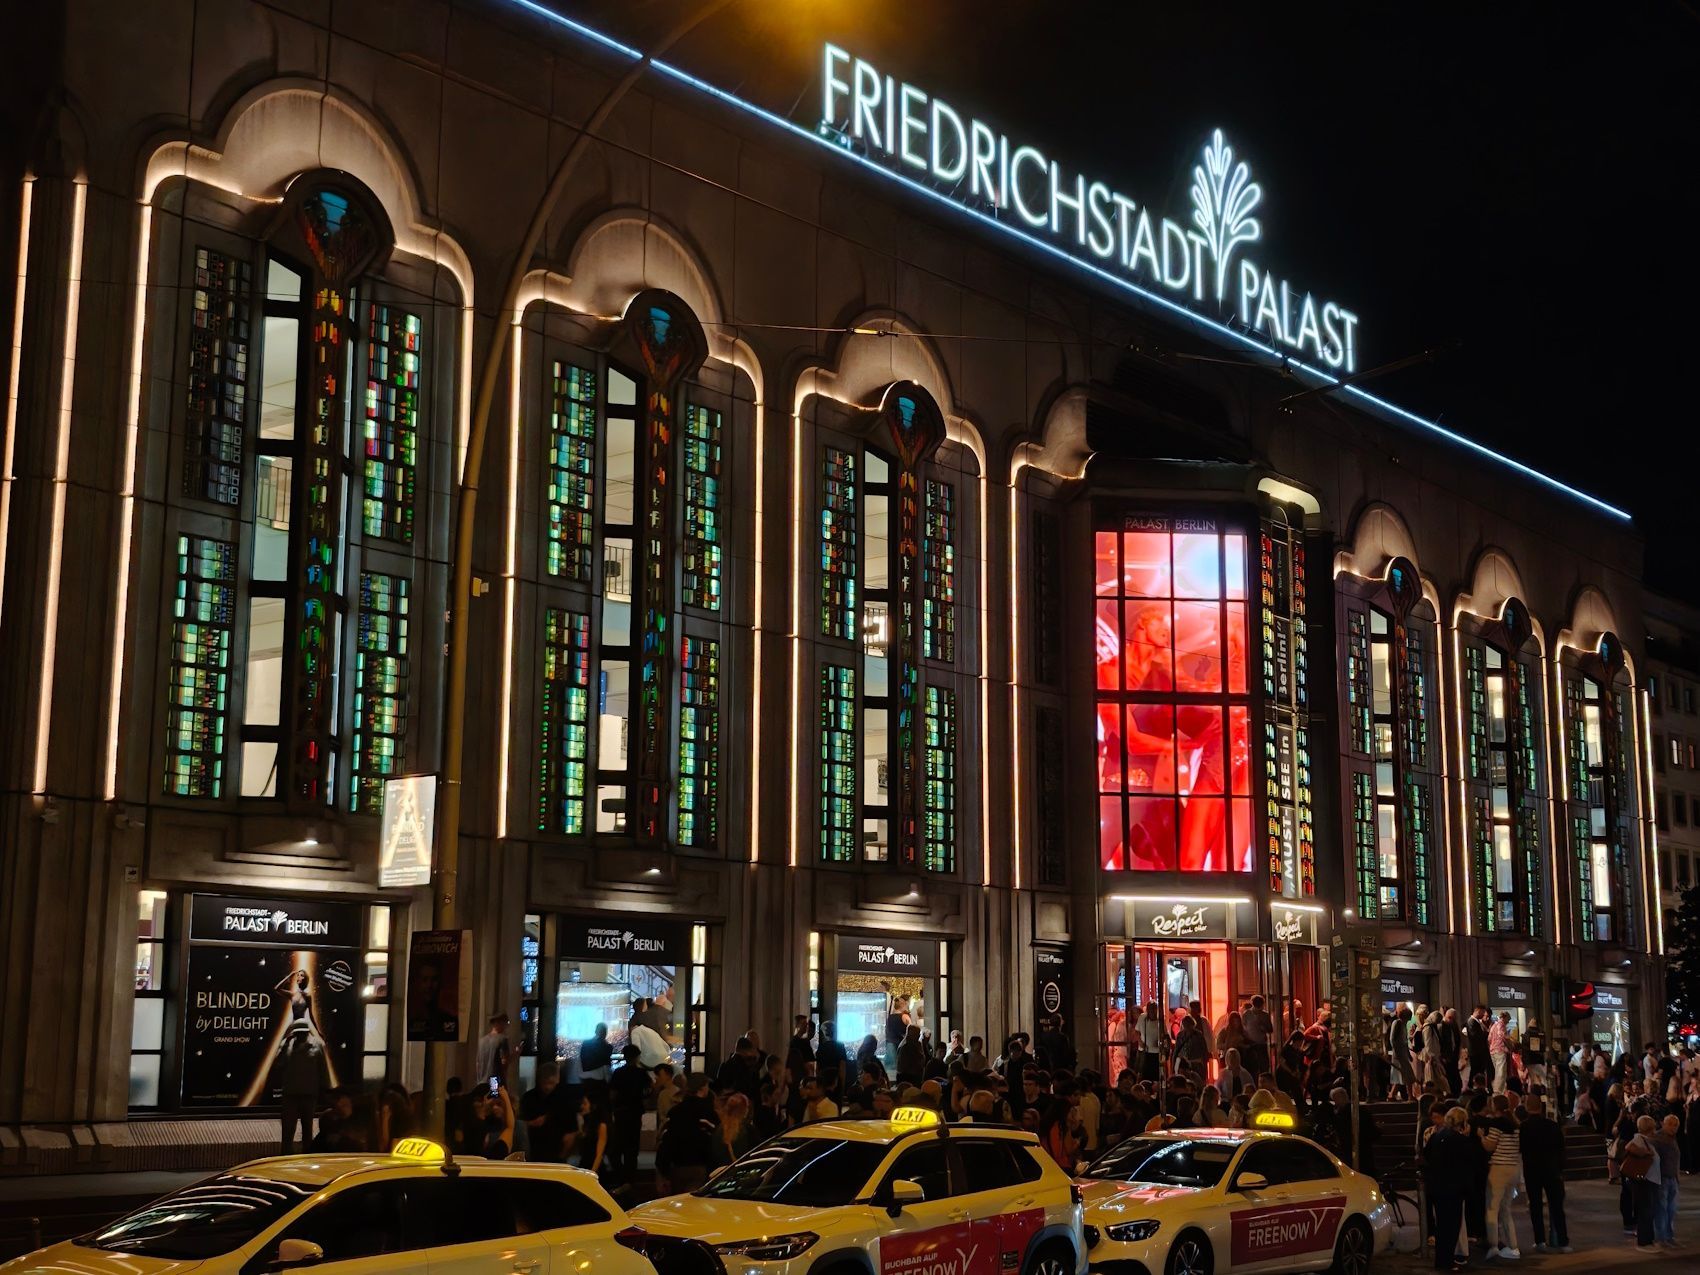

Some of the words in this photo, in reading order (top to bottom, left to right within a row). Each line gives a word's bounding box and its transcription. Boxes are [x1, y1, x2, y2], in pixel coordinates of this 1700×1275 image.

[824, 42, 1206, 300] FRIEDRICHSTADT
[1240, 259, 1358, 373] PALAST
[1125, 517, 1168, 529] PALAST
[1175, 519, 1216, 531] BERLIN
[1280, 734, 1289, 755] in
[224, 916, 271, 932] PALAST
[286, 920, 328, 934] BERLIN
[1152, 906, 1208, 936] Respect
[587, 936, 622, 949] PALAST
[633, 939, 664, 951] BERLIN
[858, 952, 885, 963] PALAST
[893, 954, 918, 965] BERLIN
[197, 992, 271, 1010] BLINDED
[196, 1016, 212, 1033] by
[213, 1016, 270, 1030] DELIGHT
[895, 1110, 926, 1122] TAXI
[395, 1141, 430, 1156] TAXI
[1249, 1221, 1310, 1248] FREENOW
[885, 1255, 921, 1270] BUCHBAR
[923, 1252, 938, 1262] AUF
